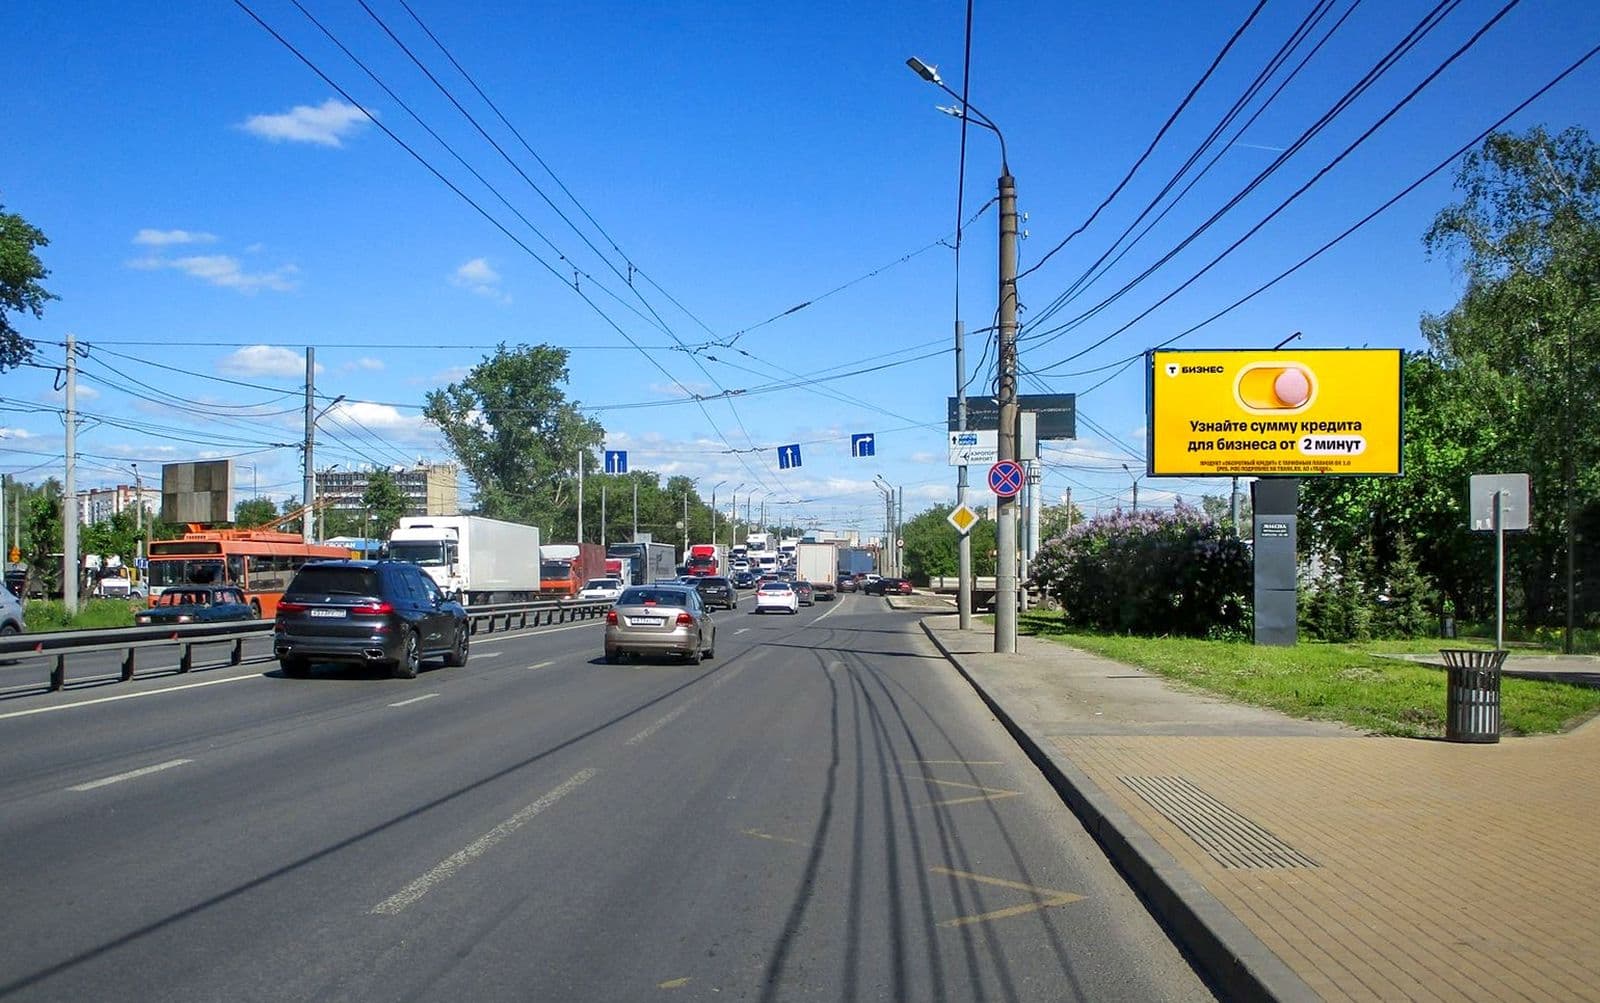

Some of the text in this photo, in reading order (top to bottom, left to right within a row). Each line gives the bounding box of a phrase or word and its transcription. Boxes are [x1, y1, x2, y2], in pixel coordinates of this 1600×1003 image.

[1182, 366, 1224, 374] БИЗНЕС
[1190, 420, 1362, 434] Узнайте сумму кредита
[1187, 438, 1361, 452] для бизнеса от 2 минут
